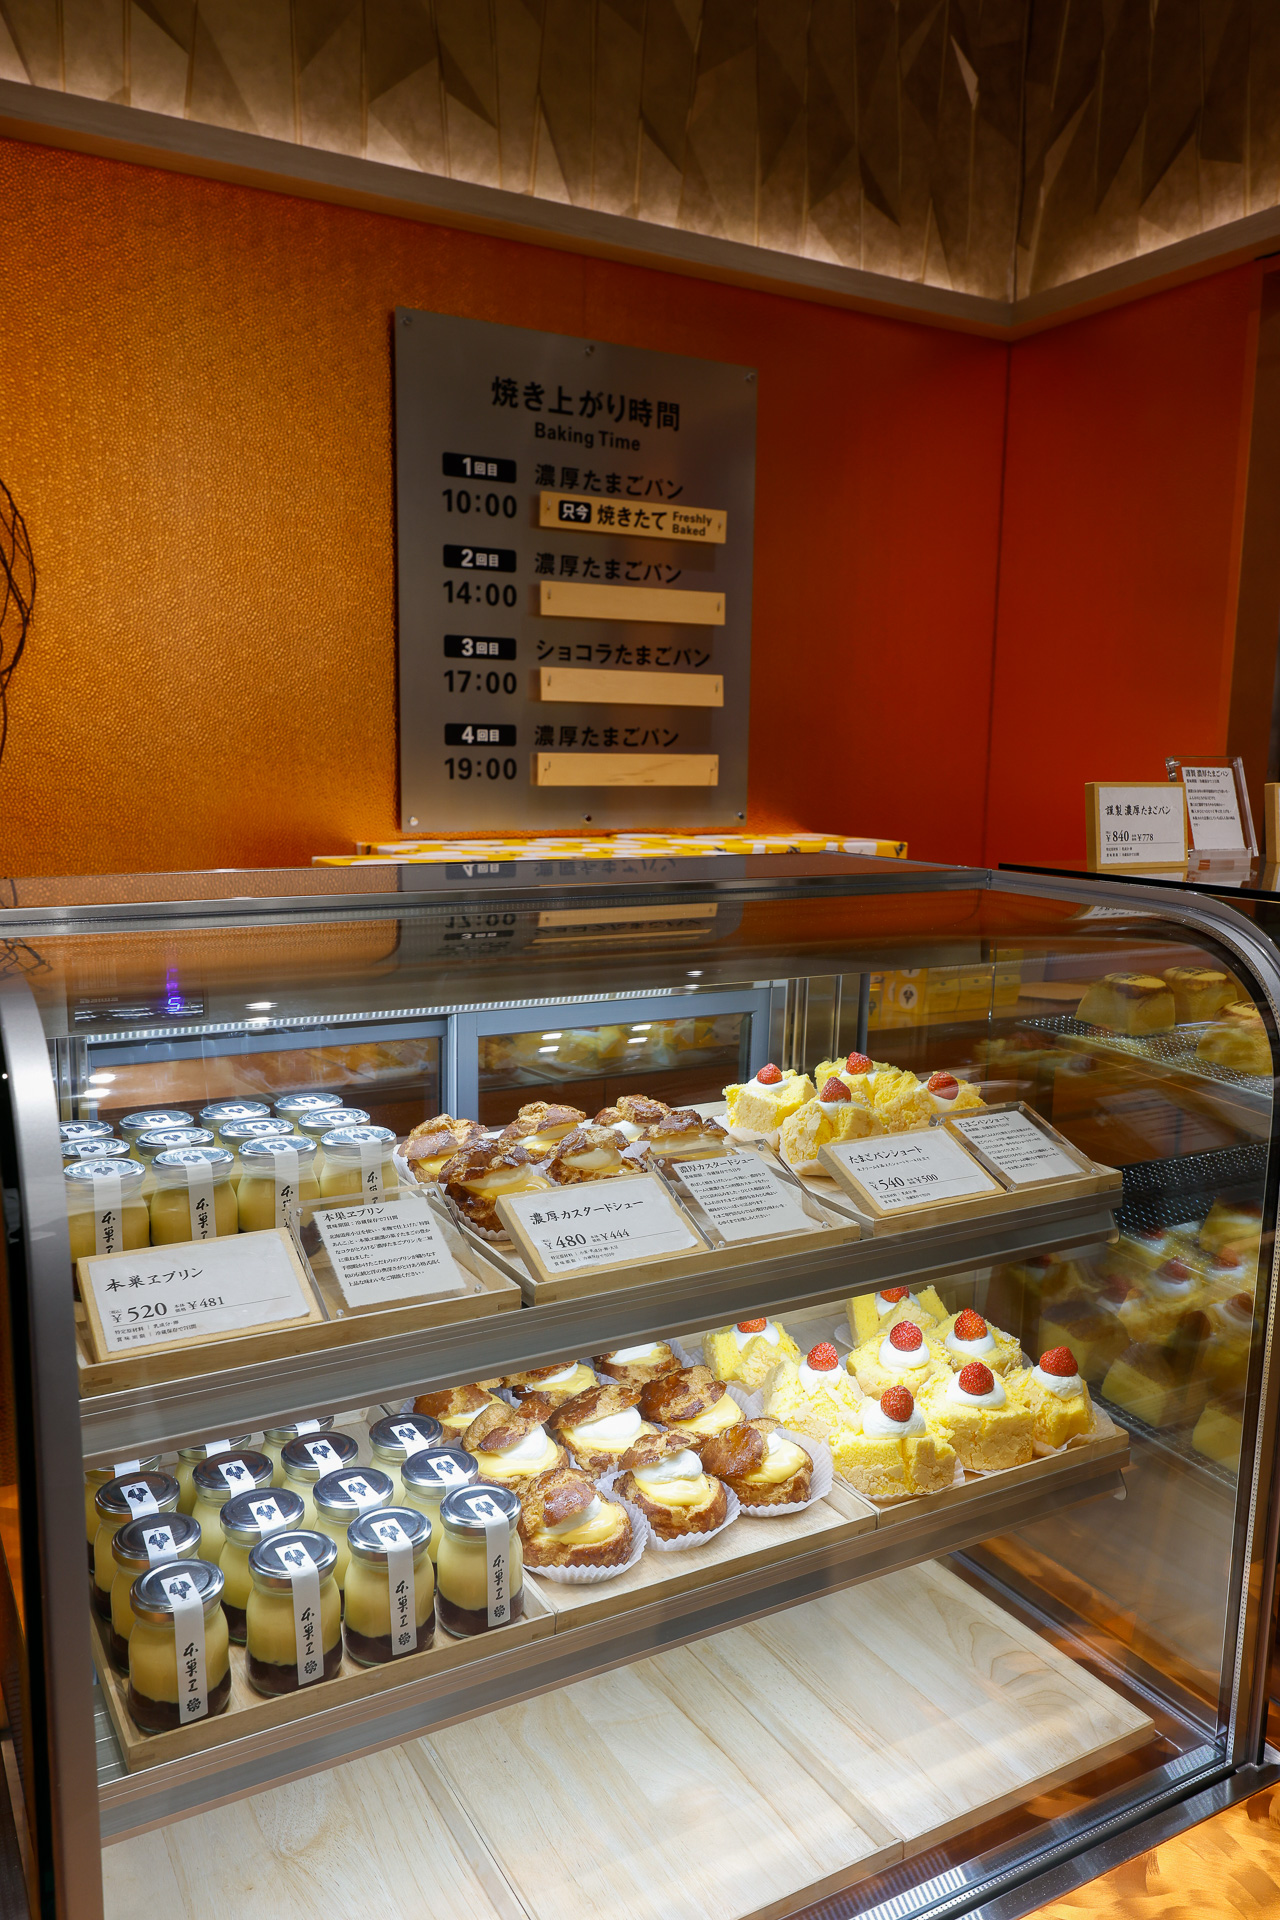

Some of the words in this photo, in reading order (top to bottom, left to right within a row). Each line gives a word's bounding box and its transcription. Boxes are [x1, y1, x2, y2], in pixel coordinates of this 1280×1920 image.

[491, 376, 681, 432] 焼き上がり時間
[534, 421, 595, 449] Baking
[599, 430, 641, 452] Time
[462, 457, 498, 477] 1回目
[534, 463, 684, 500] 濃厚たまごパン
[442, 489, 517, 518] 10:00
[562, 504, 589, 521] 只今
[597, 504, 668, 531] 焼きたて
[672, 511, 712, 526] Freshly
[672, 523, 706, 537] Baked
[461, 548, 499, 568] 2回目
[534, 552, 682, 583] 濃厚たまごパン
[443, 580, 517, 607] 14:00
[461, 637, 499, 656] 3回目
[535, 639, 710, 668] ショコラたまごパン
[443, 669, 517, 694] 17:00
[461, 725, 500, 743] 4回目
[534, 724, 679, 748] 濃厚たまごパン
[444, 757, 517, 780] 19:00
[1105, 805, 1123, 817] 謹製
[1124, 804, 1171, 817] 濃厚たまごパン
[848, 1145, 923, 1164] たまごパンショート
[915, 1173, 939, 1184] ¥500
[529, 1200, 644, 1225] 濃厚カスタードシュー
[601, 1229, 630, 1241] ¥444
[105, 1267, 204, 1292] 本巣ヱプリン
[188, 1296, 225, 1310] ¥481
